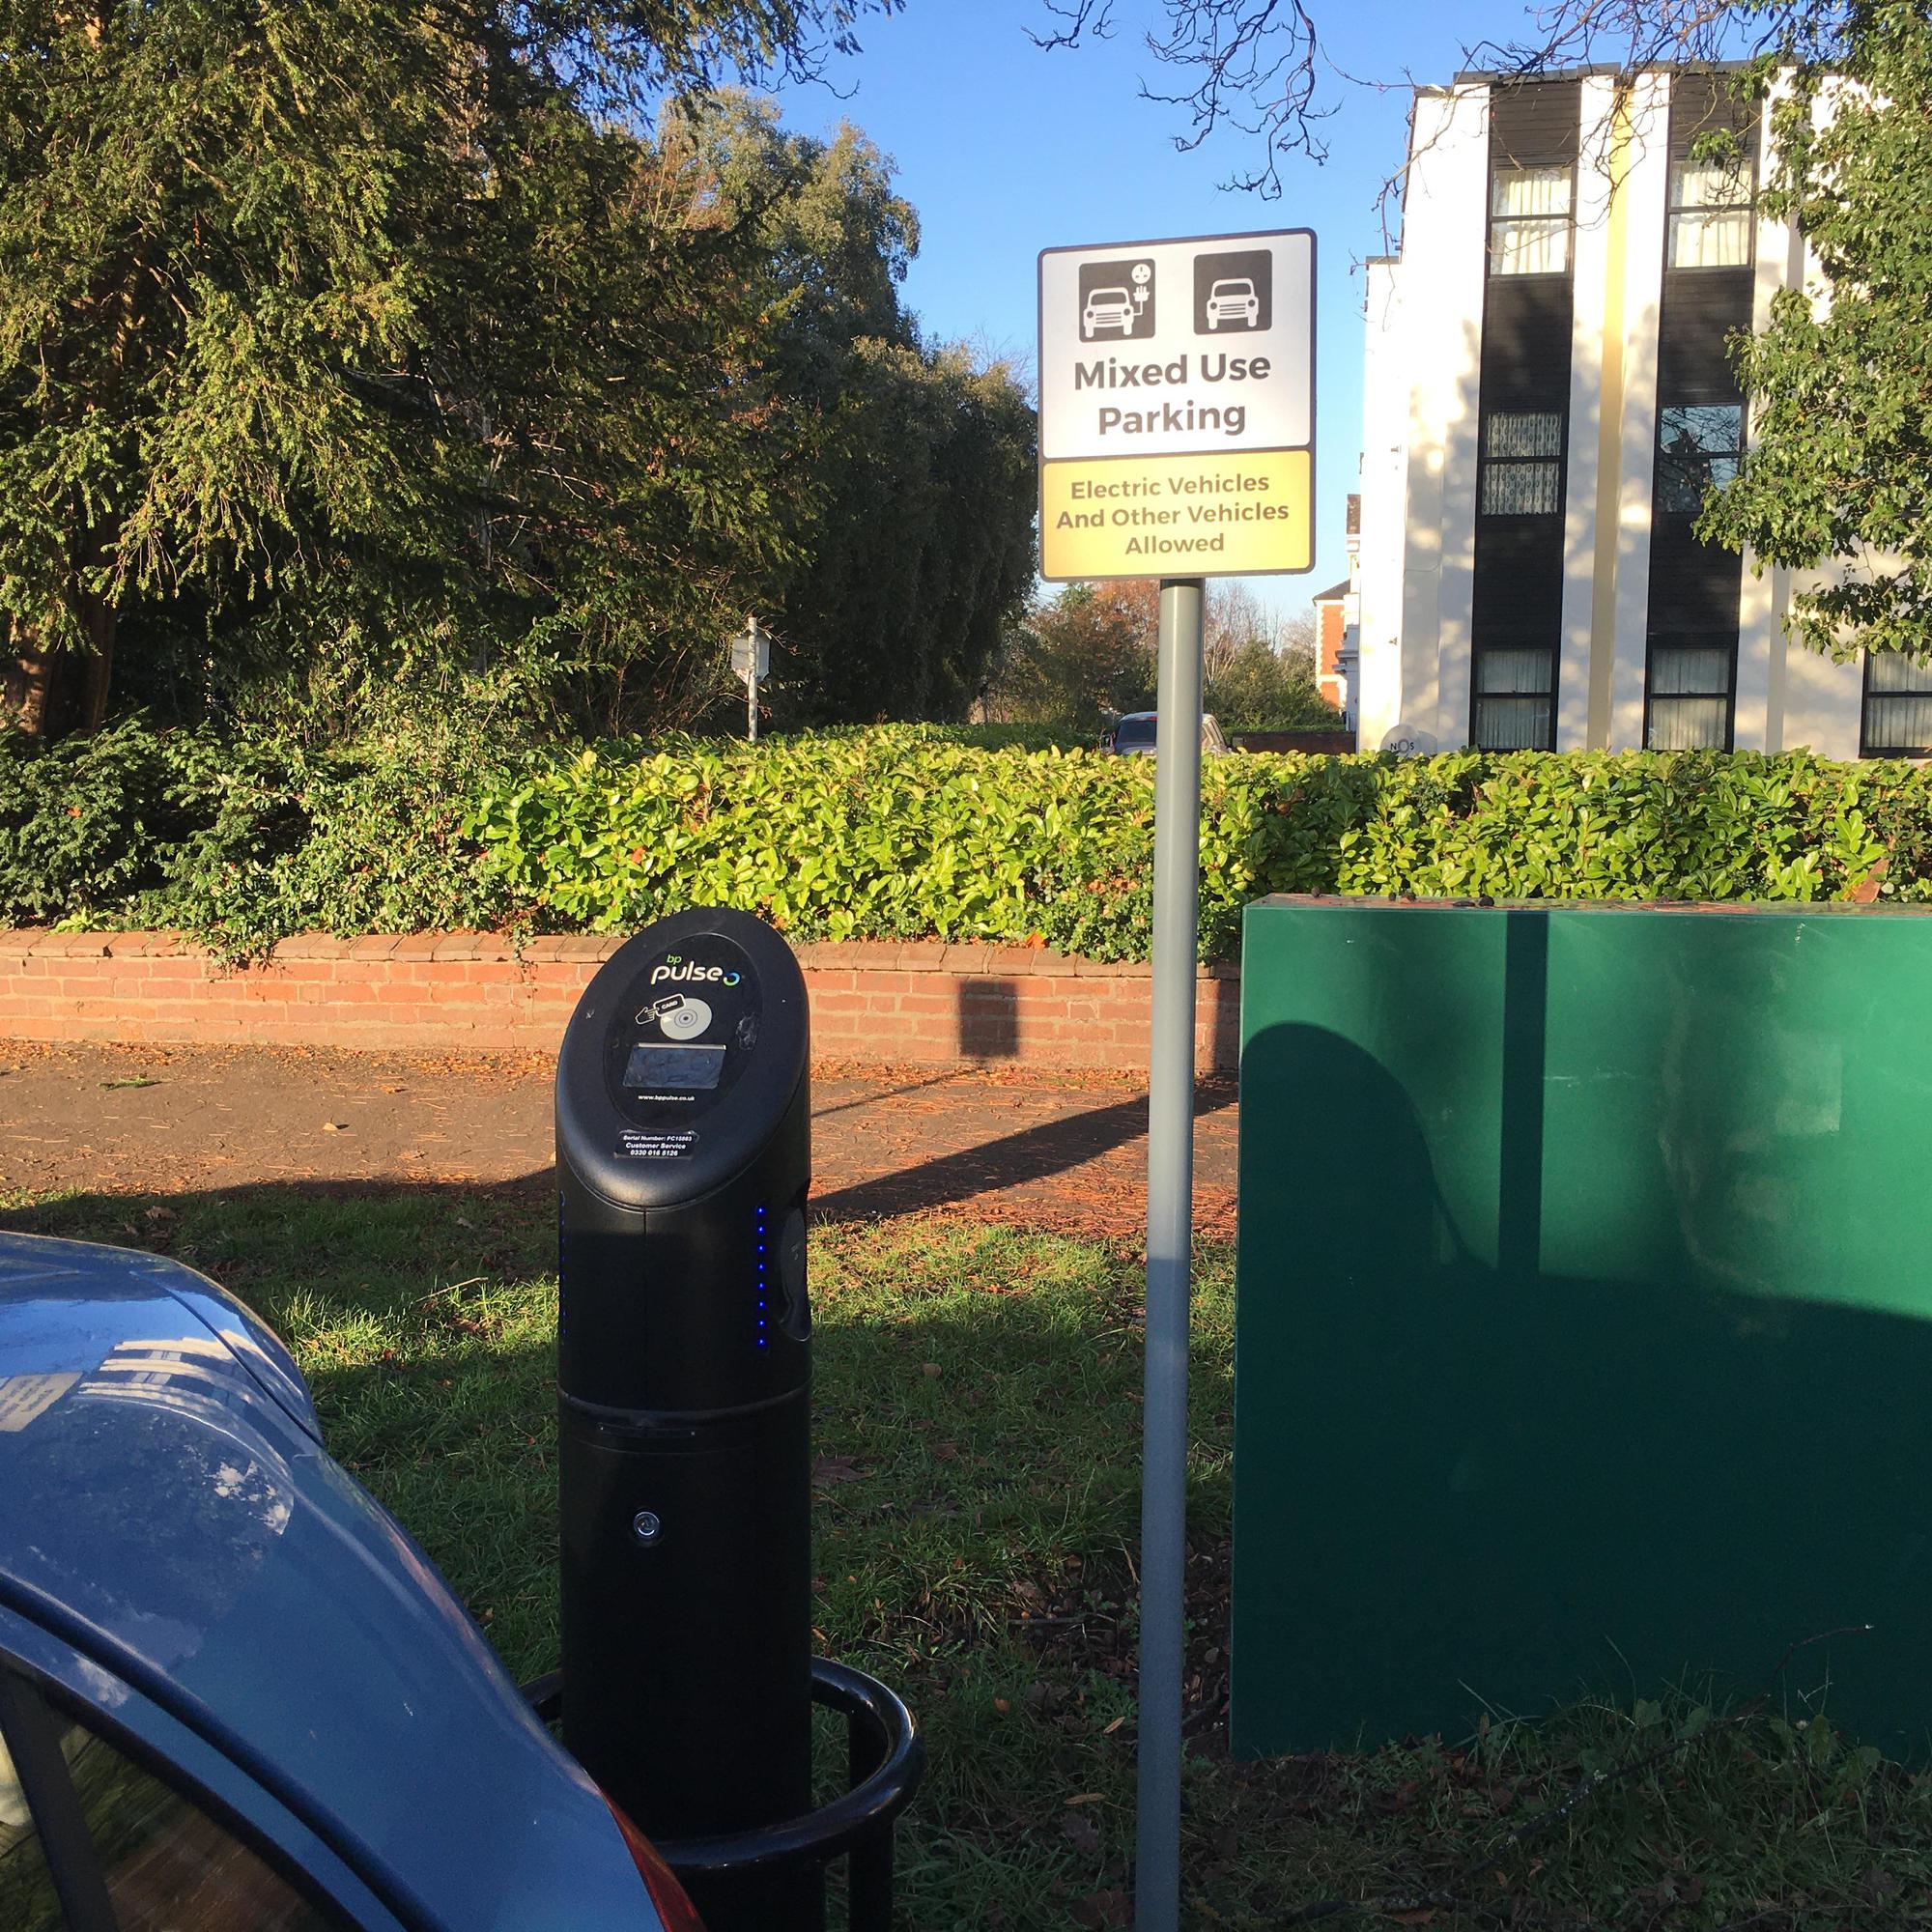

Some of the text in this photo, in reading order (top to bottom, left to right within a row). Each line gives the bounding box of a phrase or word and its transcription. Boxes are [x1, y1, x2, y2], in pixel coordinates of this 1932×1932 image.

[1074, 354, 1271, 390] Mixed Use
[1098, 400, 1246, 436] Parking
[1071, 473, 1270, 499] Electric Vehicles
[1056, 501, 1290, 529] And Other Vehicles
[1124, 532, 1225, 555] Allowed
[667, 953, 682, 965] bp
[651, 960, 724, 985] pulse
[661, 1000, 678, 1009] CARD
